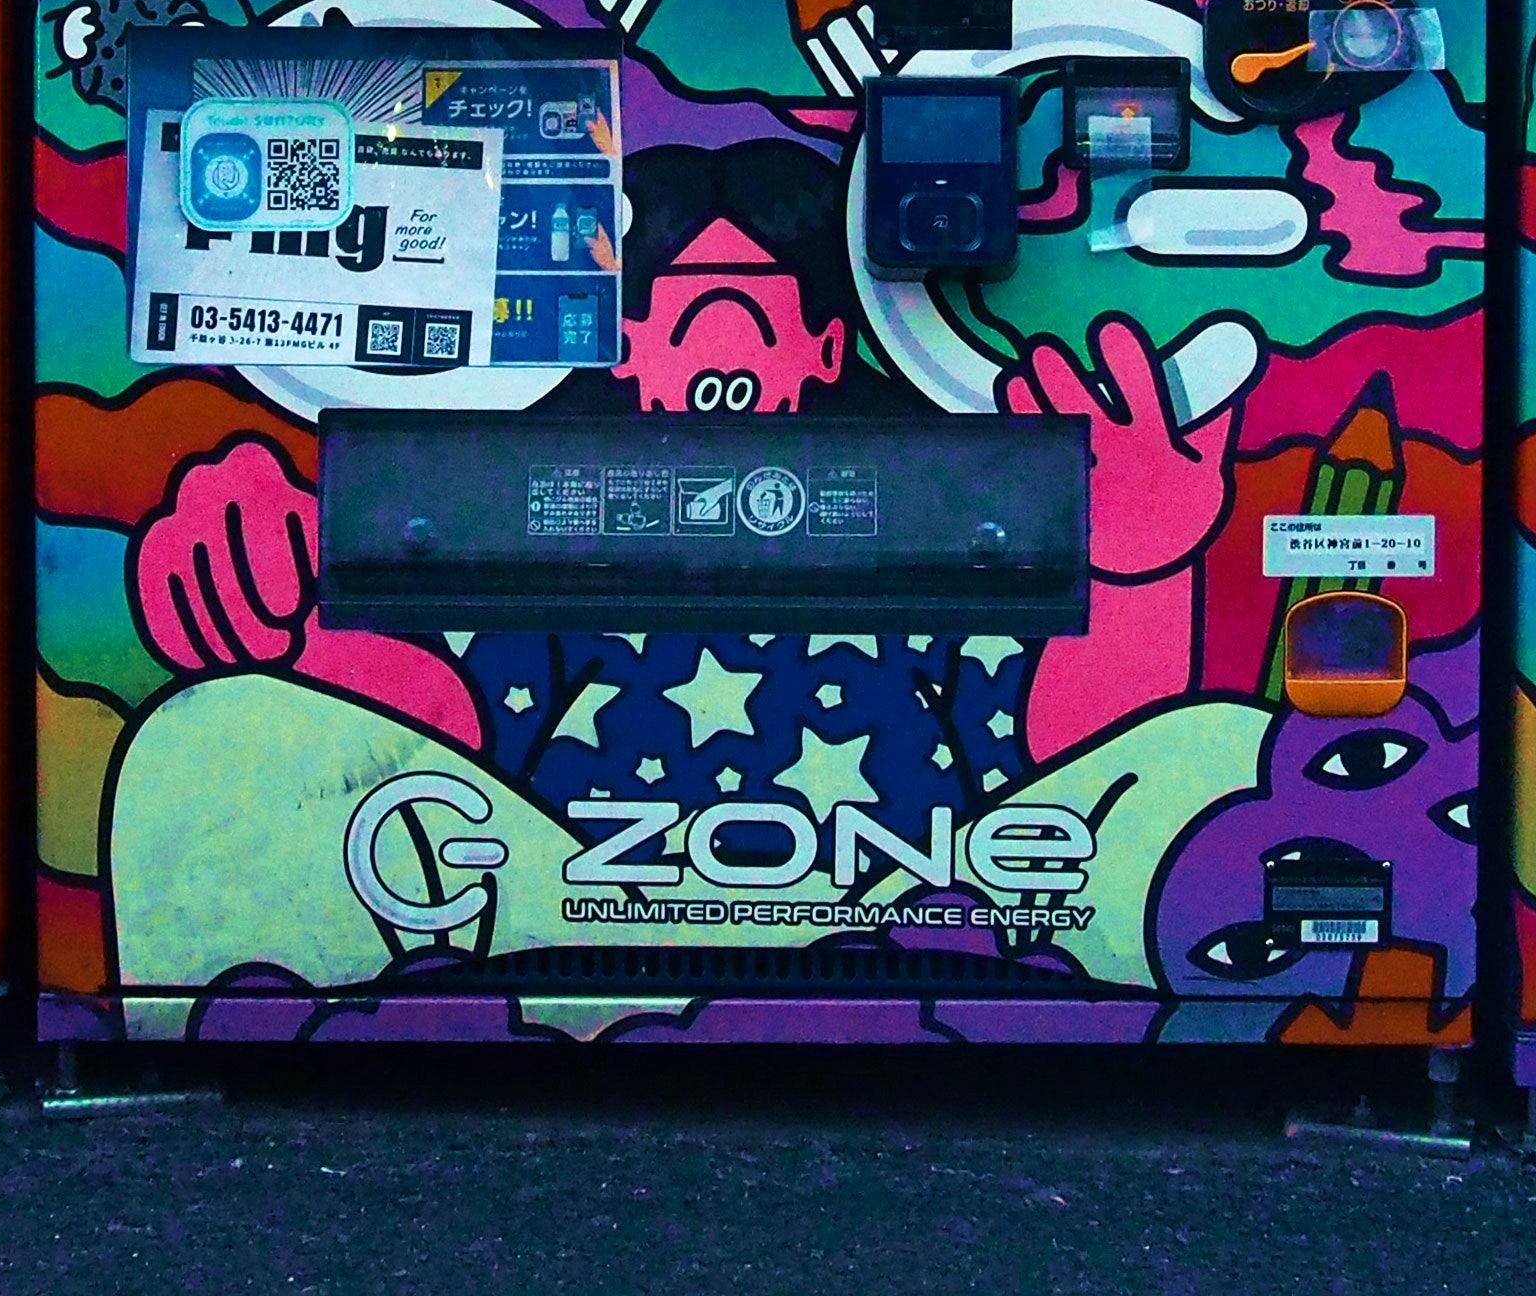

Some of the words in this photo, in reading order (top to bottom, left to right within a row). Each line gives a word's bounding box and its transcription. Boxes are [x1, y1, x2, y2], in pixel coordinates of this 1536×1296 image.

[409, 209, 438, 223] For
[395, 223, 432, 237] more
[399, 236, 447, 252] good!
[190, 304, 344, 339] 03-5413-4471
[561, 897, 727, 923] UNLIMITED
[731, 900, 964, 928] PERFORMANCE
[968, 903, 1095, 931] ENERGY
